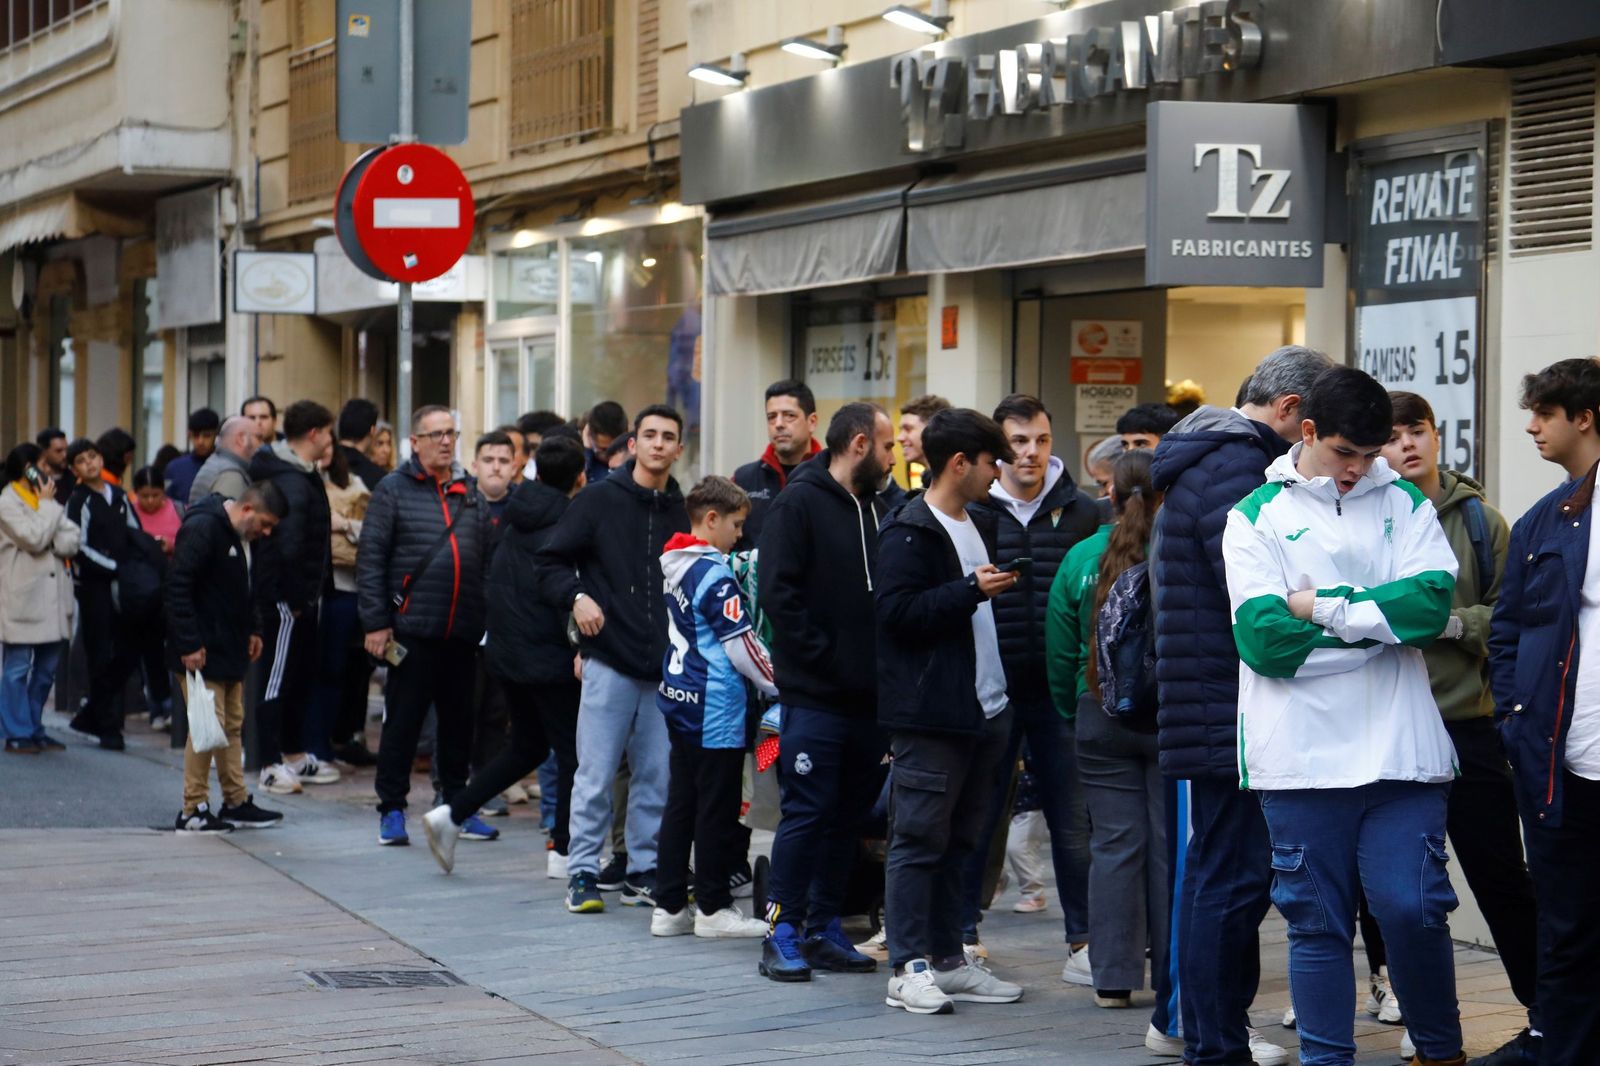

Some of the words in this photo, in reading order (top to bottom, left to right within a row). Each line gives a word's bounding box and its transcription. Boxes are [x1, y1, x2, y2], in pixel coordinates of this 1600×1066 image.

[1194, 143, 1292, 218] Tz
[1370, 165, 1476, 225] REMATE
[1171, 239, 1312, 258] FABRICANTES
[1384, 232, 1462, 286] FINAL
[1363, 346, 1416, 382] CAMISAS
[1435, 330, 1474, 386] 15
[1081, 387, 1134, 399] HORARIO
[1082, 573, 1100, 587] PAS
